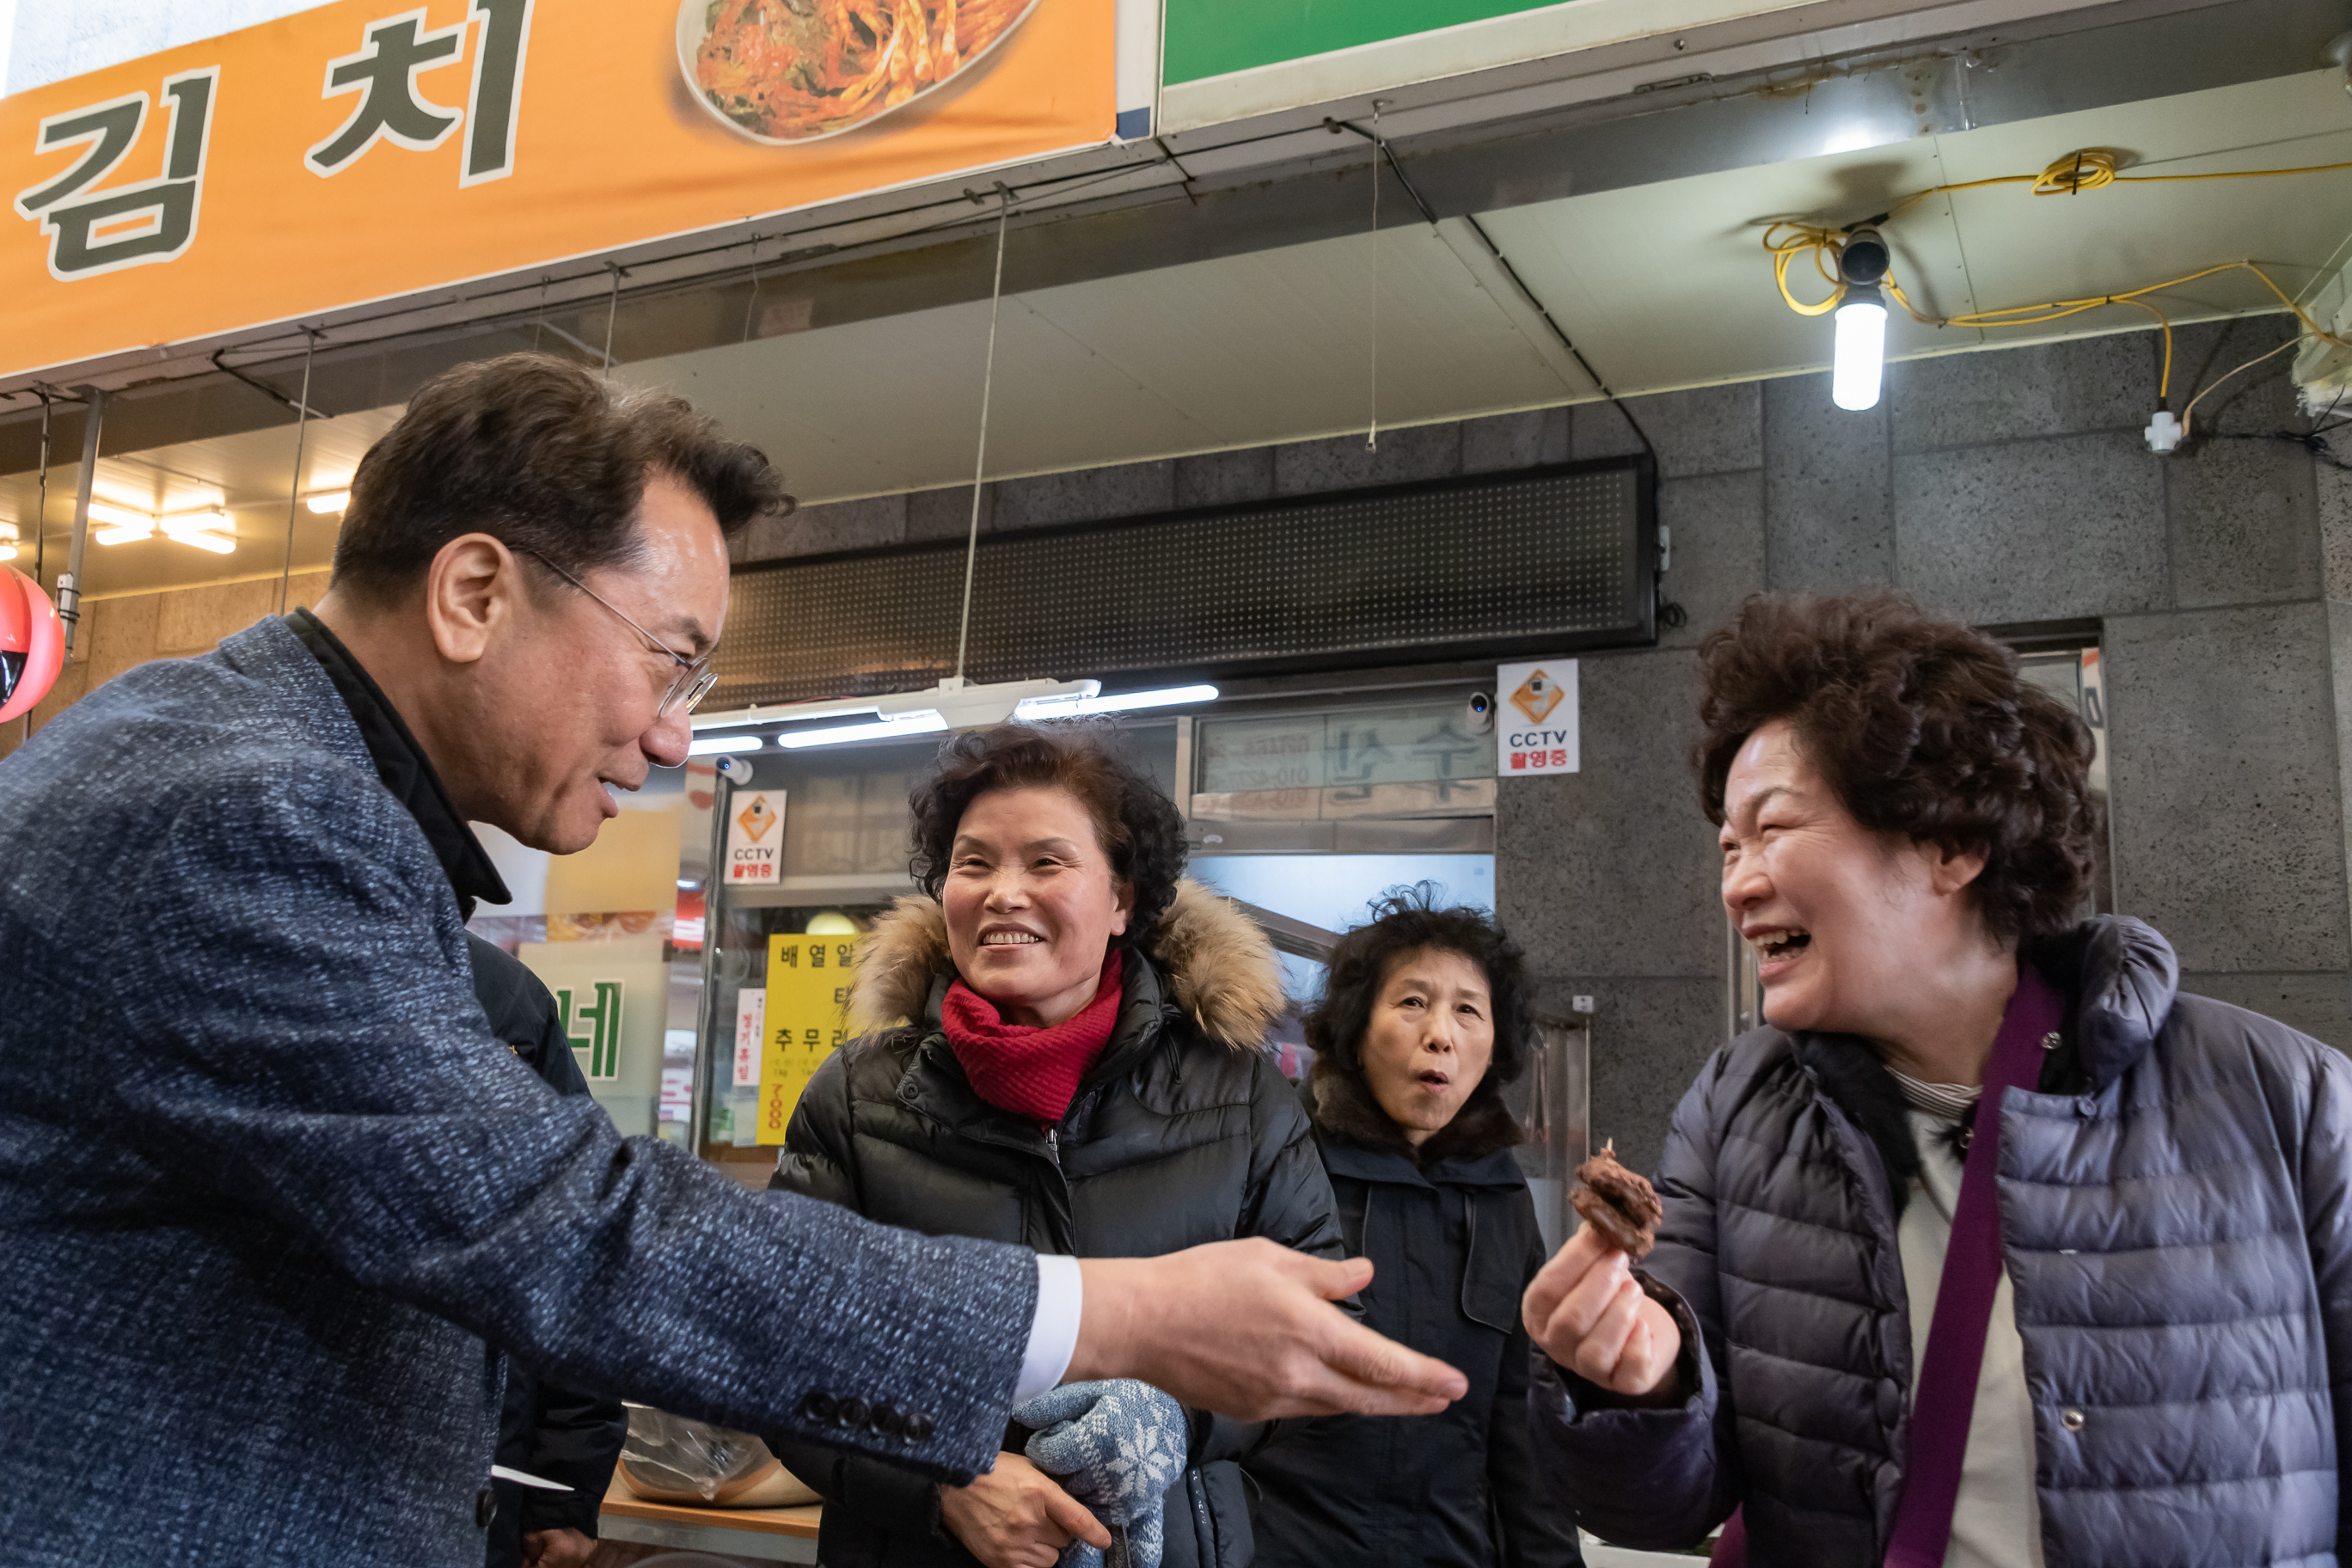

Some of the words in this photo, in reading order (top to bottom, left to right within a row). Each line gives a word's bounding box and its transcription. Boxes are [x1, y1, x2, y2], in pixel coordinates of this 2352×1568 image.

[14, 0, 535, 282] 김치
[1509, 730, 1567, 748] CCTV
[1510, 749, 1568, 769] 촬영중
[734, 848, 774, 861] CCTV
